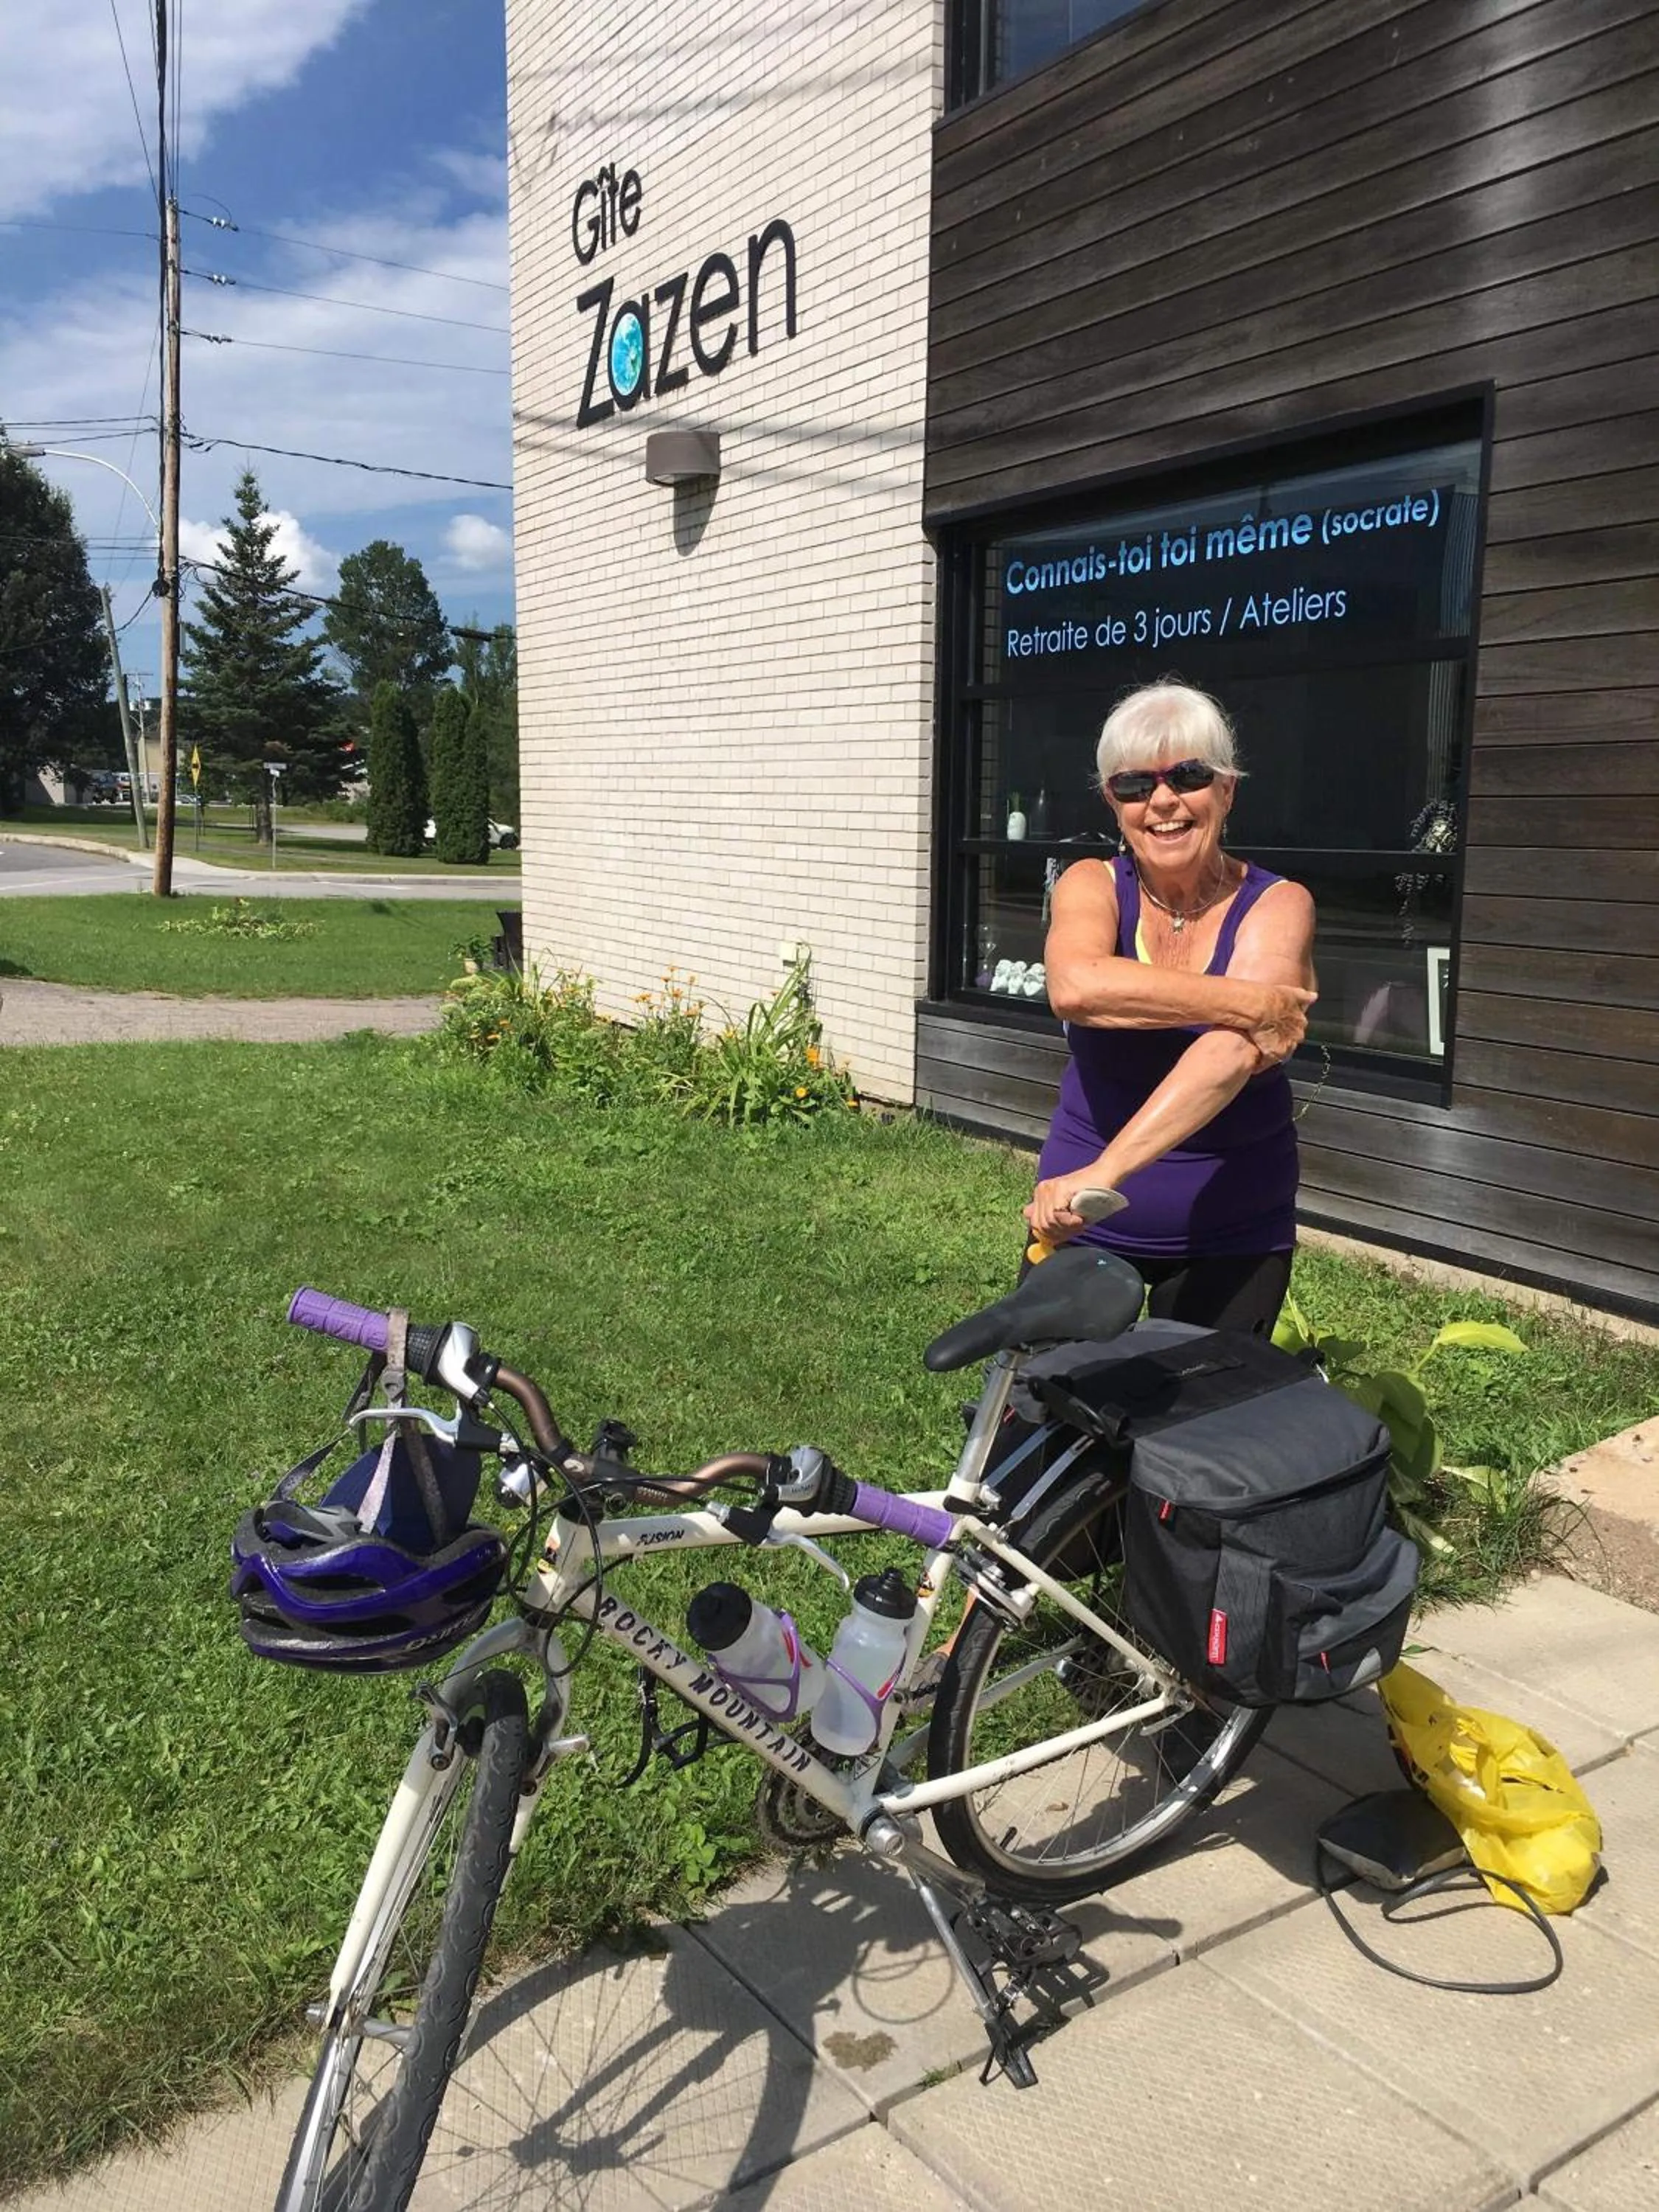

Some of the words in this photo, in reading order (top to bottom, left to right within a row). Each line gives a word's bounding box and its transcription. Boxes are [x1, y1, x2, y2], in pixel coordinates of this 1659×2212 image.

[572, 162, 642, 265] Gîte
[577, 218, 797, 429] Zazen
[1006, 535, 1152, 594] Connais-toi
[1161, 526, 1197, 567] toi
[1206, 513, 1313, 560] même
[1323, 488, 1440, 544] (socrate)
[1007, 621, 1088, 658] Retraite
[1095, 614, 1127, 647] de
[1133, 611, 1148, 641] 3
[1152, 606, 1212, 647] jours
[1239, 586, 1346, 628] Ateliers
[601, 1596, 687, 1670] ROCKY
[688, 1672, 813, 1772] MOUNTAIN
